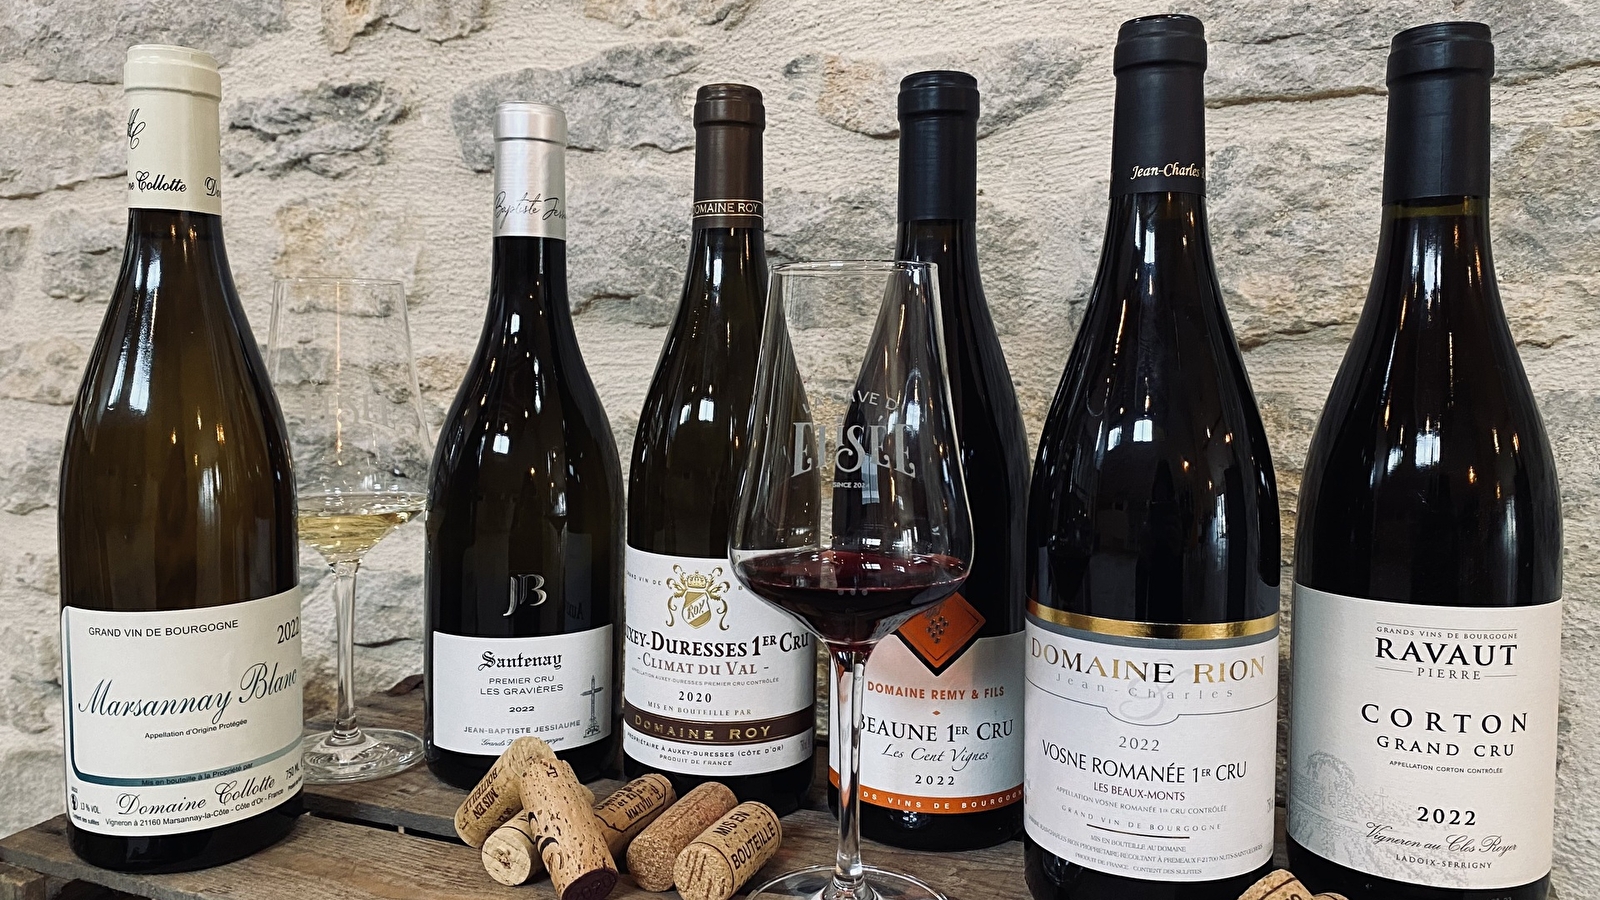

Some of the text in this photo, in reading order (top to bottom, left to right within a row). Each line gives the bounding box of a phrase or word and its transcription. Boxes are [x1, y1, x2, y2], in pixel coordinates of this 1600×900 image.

[1130, 161, 1200, 180] Jean-Charles
[136, 171, 187, 192] Collotte
[694, 202, 758, 214] OMAINE ROY
[832, 481, 851, 489] SINCE
[639, 575, 648, 583] VIN
[502, 573, 547, 617] JB
[88, 619, 239, 638] GRAND VIN DE BOURGOGNE
[277, 617, 299, 645] 2022
[1376, 626, 1415, 636] GRANDS
[1419, 630, 1442, 638] VINS
[1464, 632, 1518, 640] BOURGOGNE
[779, 631, 809, 652] CRU
[1375, 637, 1518, 666] RAVAUT
[477, 650, 562, 672] Santenay
[641, 651, 757, 676] CLIMAT DU VAL
[1031, 636, 1265, 684] DOMAINE RION
[489, 675, 555, 685] PREMIER CRU
[746, 676, 780, 686] CONTRÔLÉE
[1417, 667, 1481, 680] PIERRE
[78, 661, 297, 725] Marsannay Blanc
[480, 683, 564, 696] LES GRAVIÈRES
[867, 681, 1005, 700] DOMAINE REMY & FILS
[1055, 673, 1233, 699] Jean-Charles
[678, 691, 712, 703] 2020
[509, 705, 535, 713] 2022
[647, 700, 752, 716] MIS EN BOUTEILLE PAR
[1361, 703, 1528, 734] CORTON
[144, 718, 248, 740] Appellation d'Origine Protégée
[463, 719, 581, 734] JEAN-BAPTISTE JESSIAUME
[634, 714, 771, 740] DOMAINE ROY
[946, 723, 969, 743] 1ER
[976, 718, 1014, 741] CRU
[481, 737, 506, 747] Grands
[667, 746, 735, 758] AUXEY-DURESSES
[737, 748, 761, 757] (CÔTE
[764, 744, 784, 755] D'OR)
[1118, 735, 1160, 752] 2022
[1376, 735, 1515, 757] GRAND CRU
[659, 754, 688, 764] PRODUIT
[881, 743, 989, 772] Les Cent Vignes
[1042, 739, 1247, 783] VOSNE ROMANÉE 1ER CRU
[1389, 760, 1434, 771] APPELLATION
[166, 776, 196, 784] bouteille
[212, 766, 242, 778] Propriété
[243, 762, 254, 772] par
[915, 774, 955, 786] 2022
[116, 793, 206, 815] Domaine
[214, 774, 276, 805] Collotte
[482, 787, 499, 808] MIS
[887, 789, 1022, 810] VINS DE BOURGOGN
[1056, 785, 1094, 803] APPELLATION
[1095, 799, 1118, 808] VOSNE
[1120, 802, 1156, 813] ROMANÉE
[1188, 804, 1227, 814] CONTRÔLÉE
[1093, 782, 1185, 801] LES BEAUX-MONTS
[105, 818, 132, 827] Vigneron
[133, 819, 138, 827] à
[140, 818, 161, 826] 21160
[163, 808, 230, 825] Marsannay-la-Côte
[235, 802, 251, 812] Côte
[251, 796, 264, 807] d'Or
[267, 788, 284, 800] France
[473, 801, 487, 820] EN
[1417, 806, 1476, 826] 2022
[712, 811, 750, 837] MIS EN
[1061, 805, 1221, 832] GRAND VIN DE BOURGOGNE
[730, 821, 776, 870] BOUTEILLE
[1366, 821, 1517, 858] Vigneron au Clos Royer
[1395, 853, 1492, 870] LADOIX-SERRIGNY
